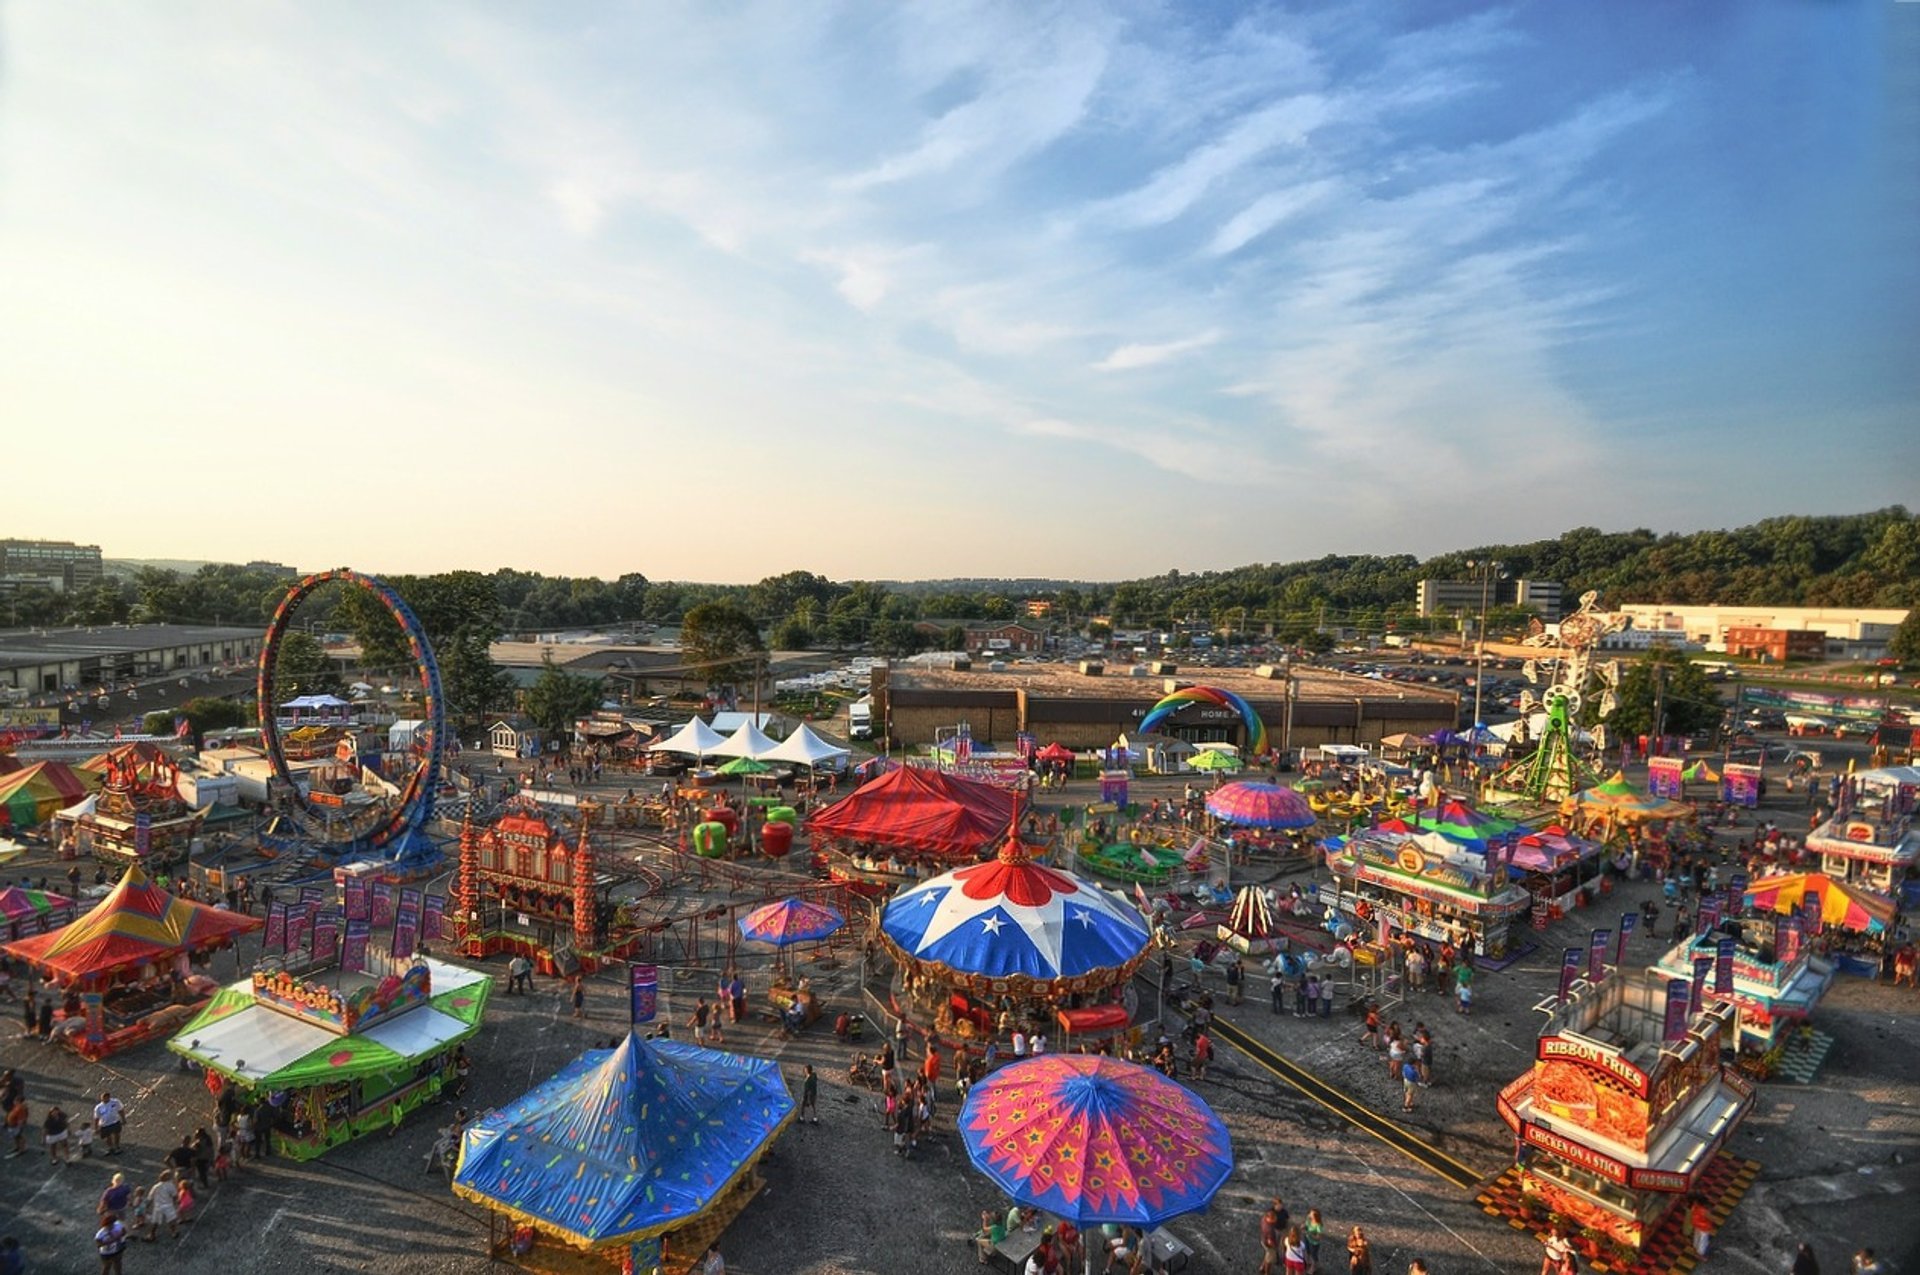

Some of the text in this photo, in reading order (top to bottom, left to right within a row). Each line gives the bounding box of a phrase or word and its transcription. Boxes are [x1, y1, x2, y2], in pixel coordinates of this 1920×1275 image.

[1201, 710, 1229, 718] HOME
[253, 971, 339, 1015] BALLOONS
[1545, 1041, 1642, 1088] RIBBON FRIES
[1529, 1127, 1622, 1177] CHICKEN ON A STICK
[1635, 1173, 1655, 1186] COLD
